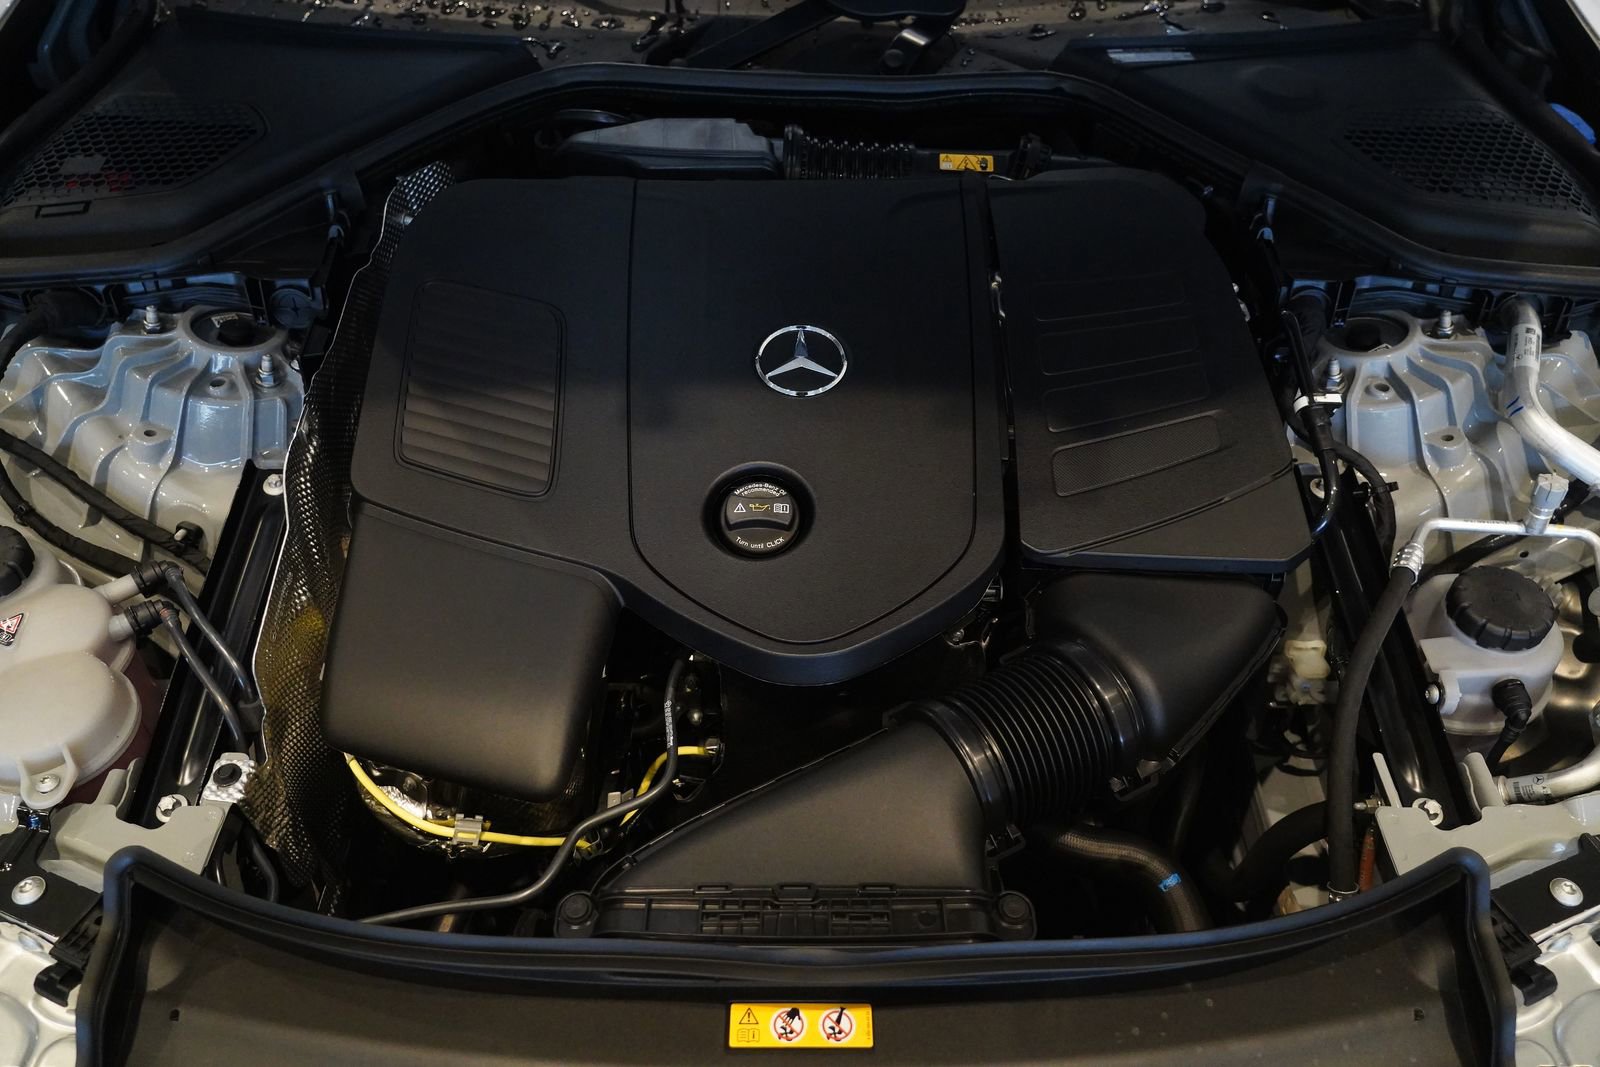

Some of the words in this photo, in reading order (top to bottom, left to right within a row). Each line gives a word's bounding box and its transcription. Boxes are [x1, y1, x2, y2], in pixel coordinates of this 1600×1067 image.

[734, 483, 779, 495] Mercedes-Benz
[741, 488, 780, 497] recommended
[736, 536, 749, 547] Turn
[766, 537, 785, 548] CLICK
